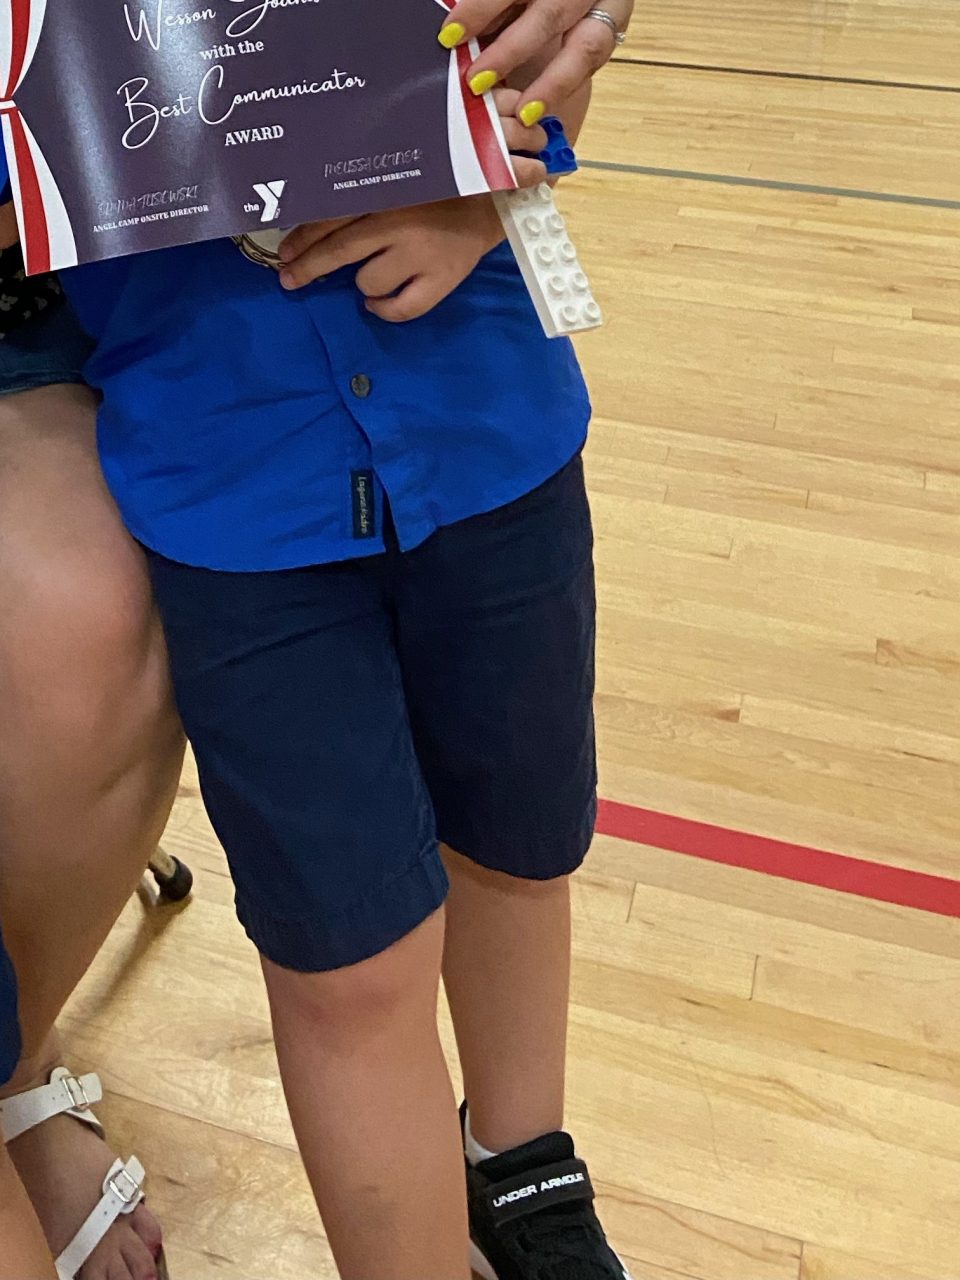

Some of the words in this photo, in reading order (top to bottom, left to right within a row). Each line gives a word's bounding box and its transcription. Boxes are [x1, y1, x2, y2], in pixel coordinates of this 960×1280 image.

[199, 44, 236, 61] with
[238, 40, 264, 54] the
[116, 77, 194, 149] Best
[197, 64, 366, 125] Communicator
[224, 125, 283, 146] AWARD
[333, 180, 359, 190] ANGEL
[360, 176, 380, 185] CAMP
[382, 169, 421, 182] DIRECTOR
[92, 223, 117, 233] ANGEL
[118, 217, 139, 228] CAMP
[141, 212, 169, 223] ONSITE
[170, 204, 209, 217] DIRECTOR
[244, 203, 259, 213] the
[493, 1184, 537, 1207] UNDER
[540, 1172, 584, 1192] ARMOUR
